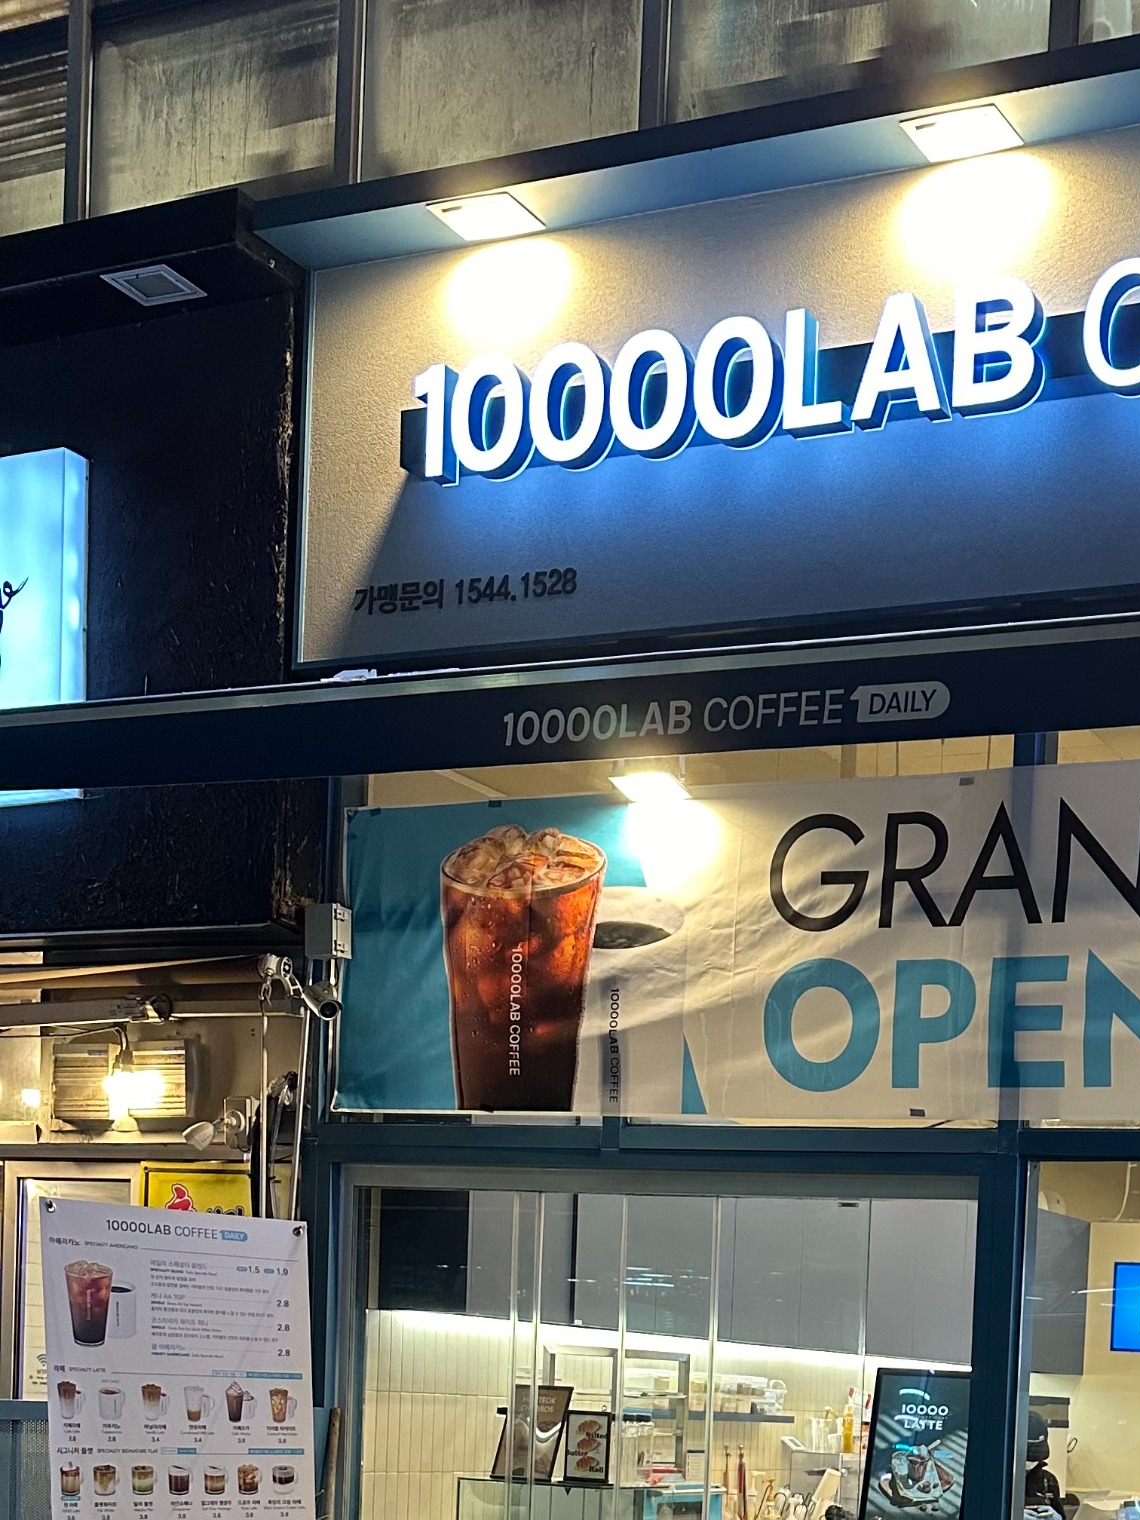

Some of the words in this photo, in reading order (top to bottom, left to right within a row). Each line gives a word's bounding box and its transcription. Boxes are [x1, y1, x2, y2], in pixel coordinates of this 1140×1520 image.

[414, 278, 1045, 483] 10000LAB
[353, 578, 445, 616] 가맹문의
[503, 702, 692, 747] 10000LAB
[702, 689, 845, 731] COFFEE
[867, 688, 938, 718] DAILY
[510, 944, 522, 1021] 10000LAB
[609, 988, 620, 1053] 10000LAB
[509, 1024, 520, 1076] COFFEE
[609, 1057, 620, 1103] COFFEE
[49, 1237, 81, 1246] 아메리카노
[106, 1219, 171, 1236] 10000LAB
[175, 1226, 218, 1240] COFFEE
[225, 1231, 245, 1241] DAILY
[248, 1265, 260, 1274] 1.5
[277, 1299, 289, 1308] 2.8
[277, 1323, 290, 1332] 2.8
[278, 1349, 290, 1357] 2.8
[904, 1420, 943, 1430] LATTE
